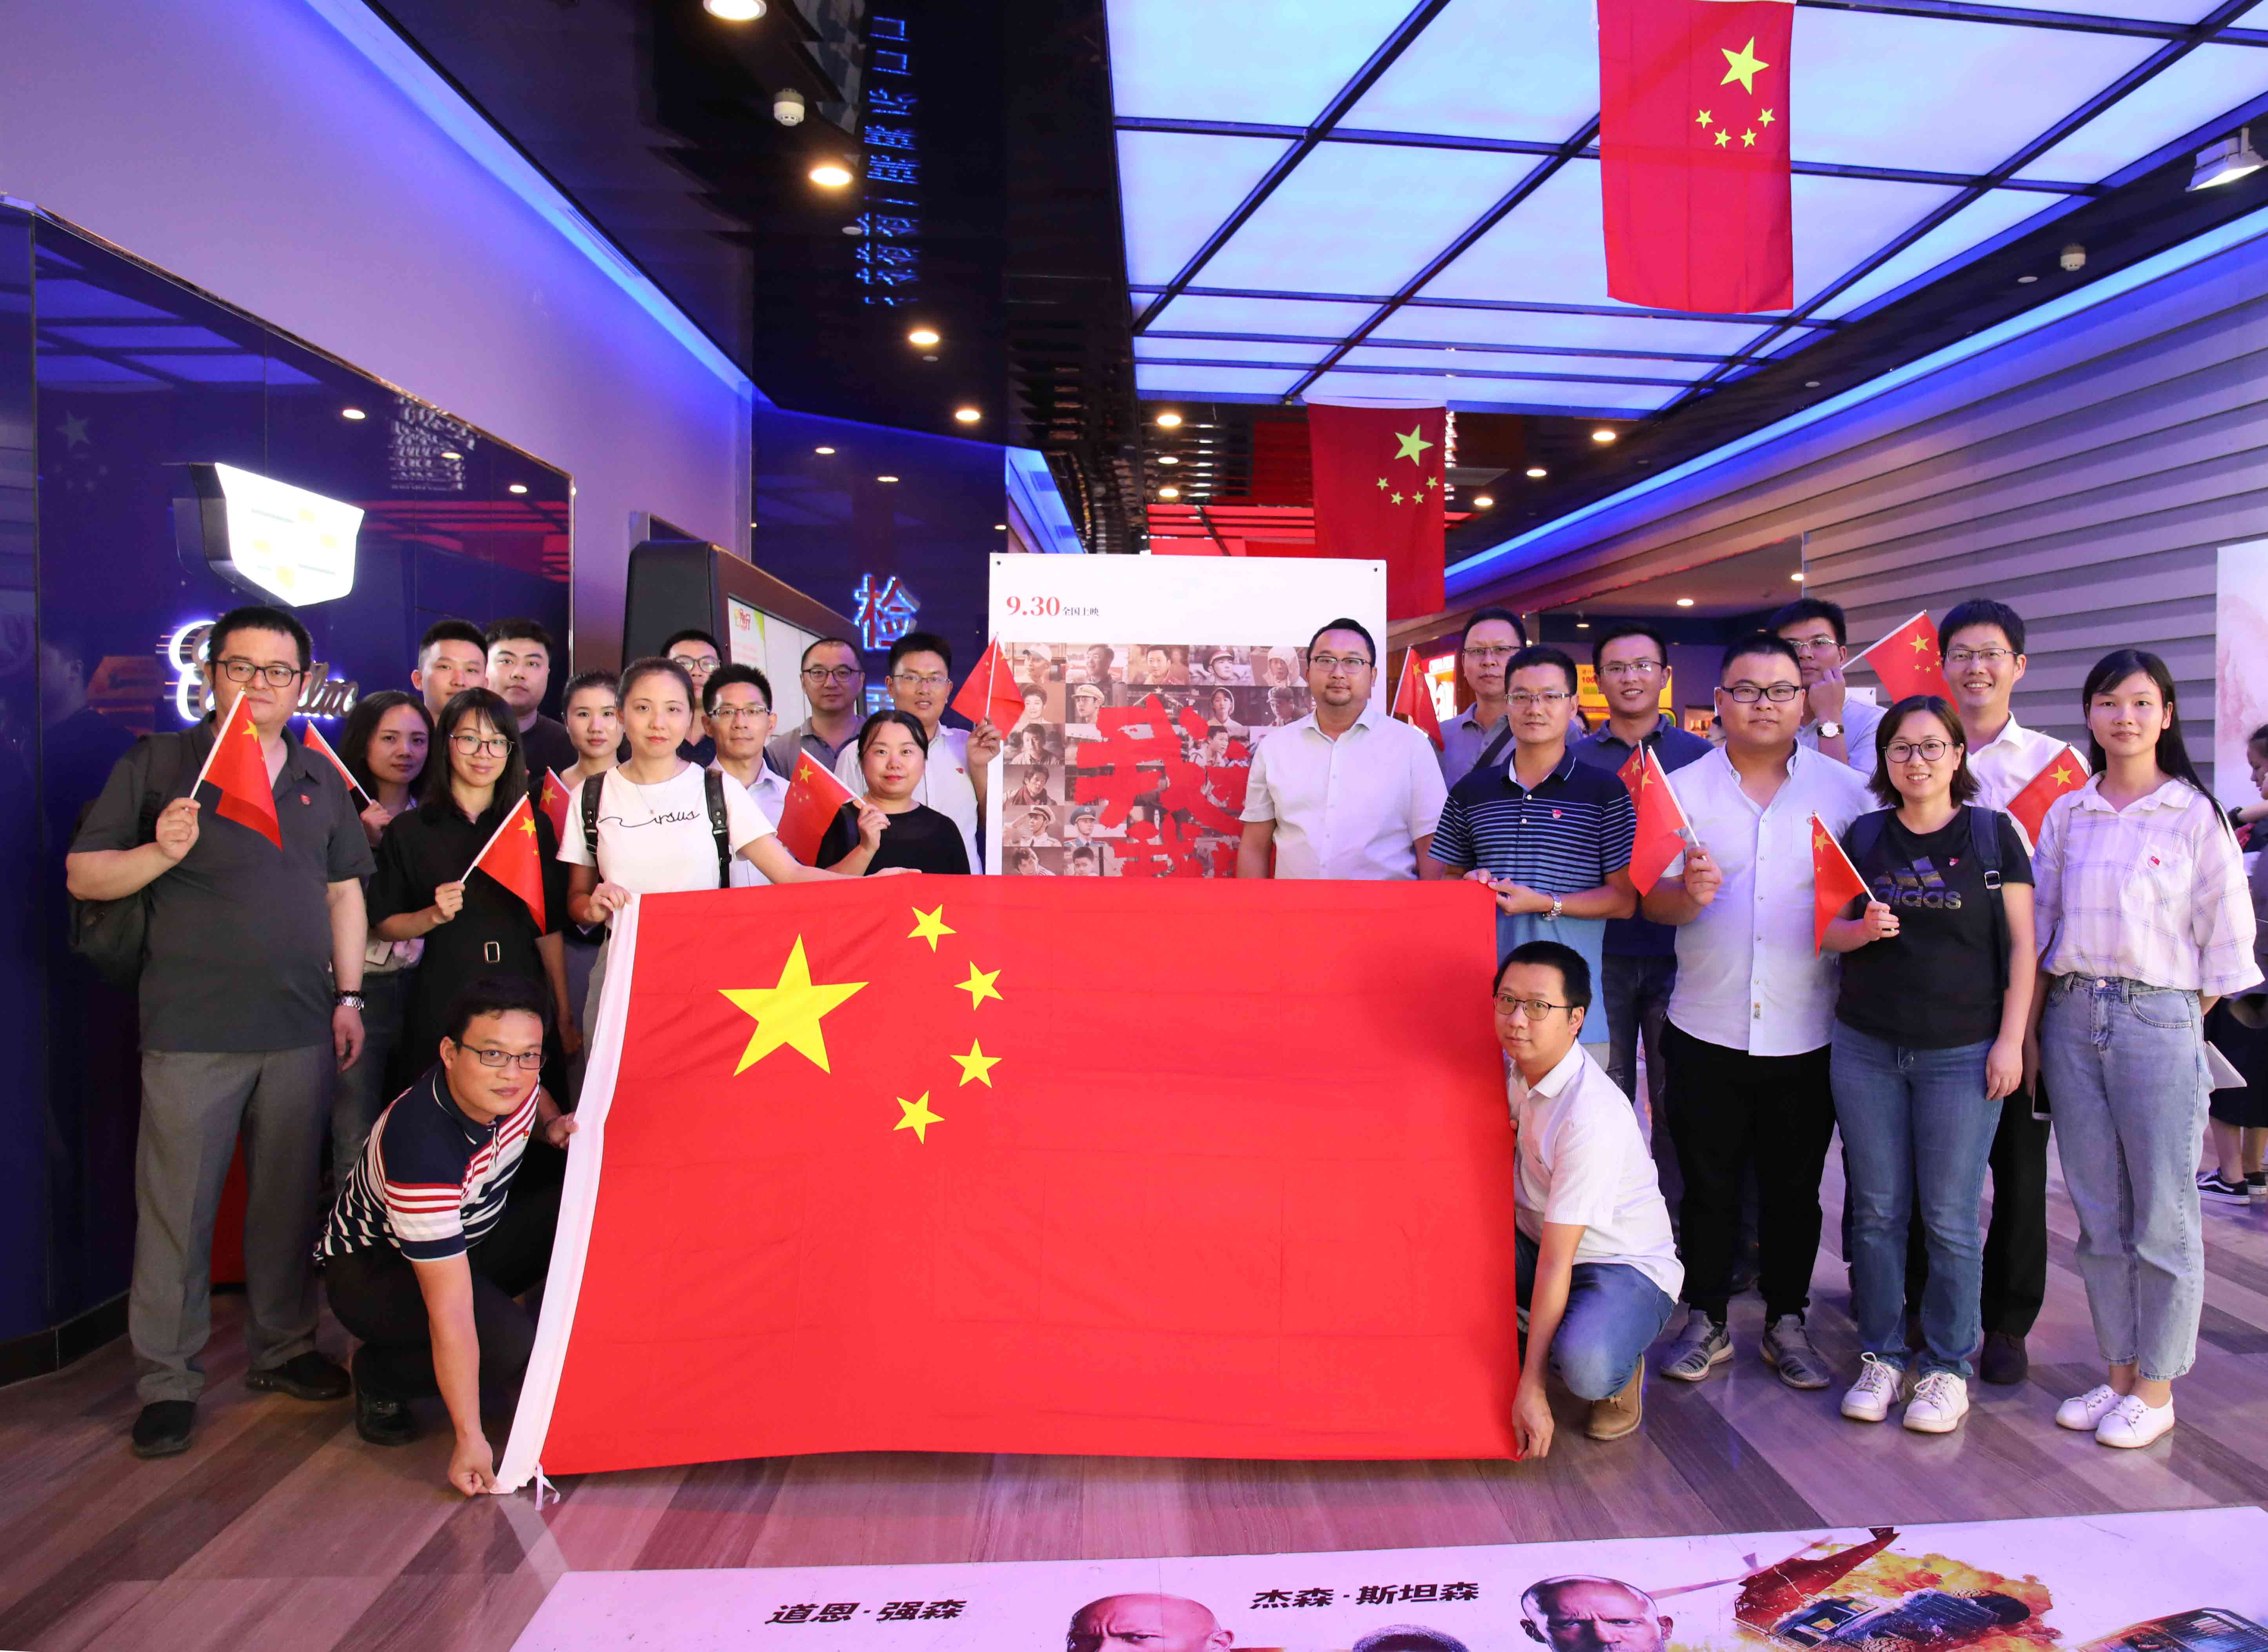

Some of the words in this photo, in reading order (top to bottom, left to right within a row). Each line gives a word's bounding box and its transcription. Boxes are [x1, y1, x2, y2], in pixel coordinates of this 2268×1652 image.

[1006, 596, 1060, 616] 9.30
[1063, 606, 1099, 617] 全国上映
[1250, 1581, 1479, 1609] 杰森·斯坦森
[764, 1599, 967, 1625] 道恩·强森
